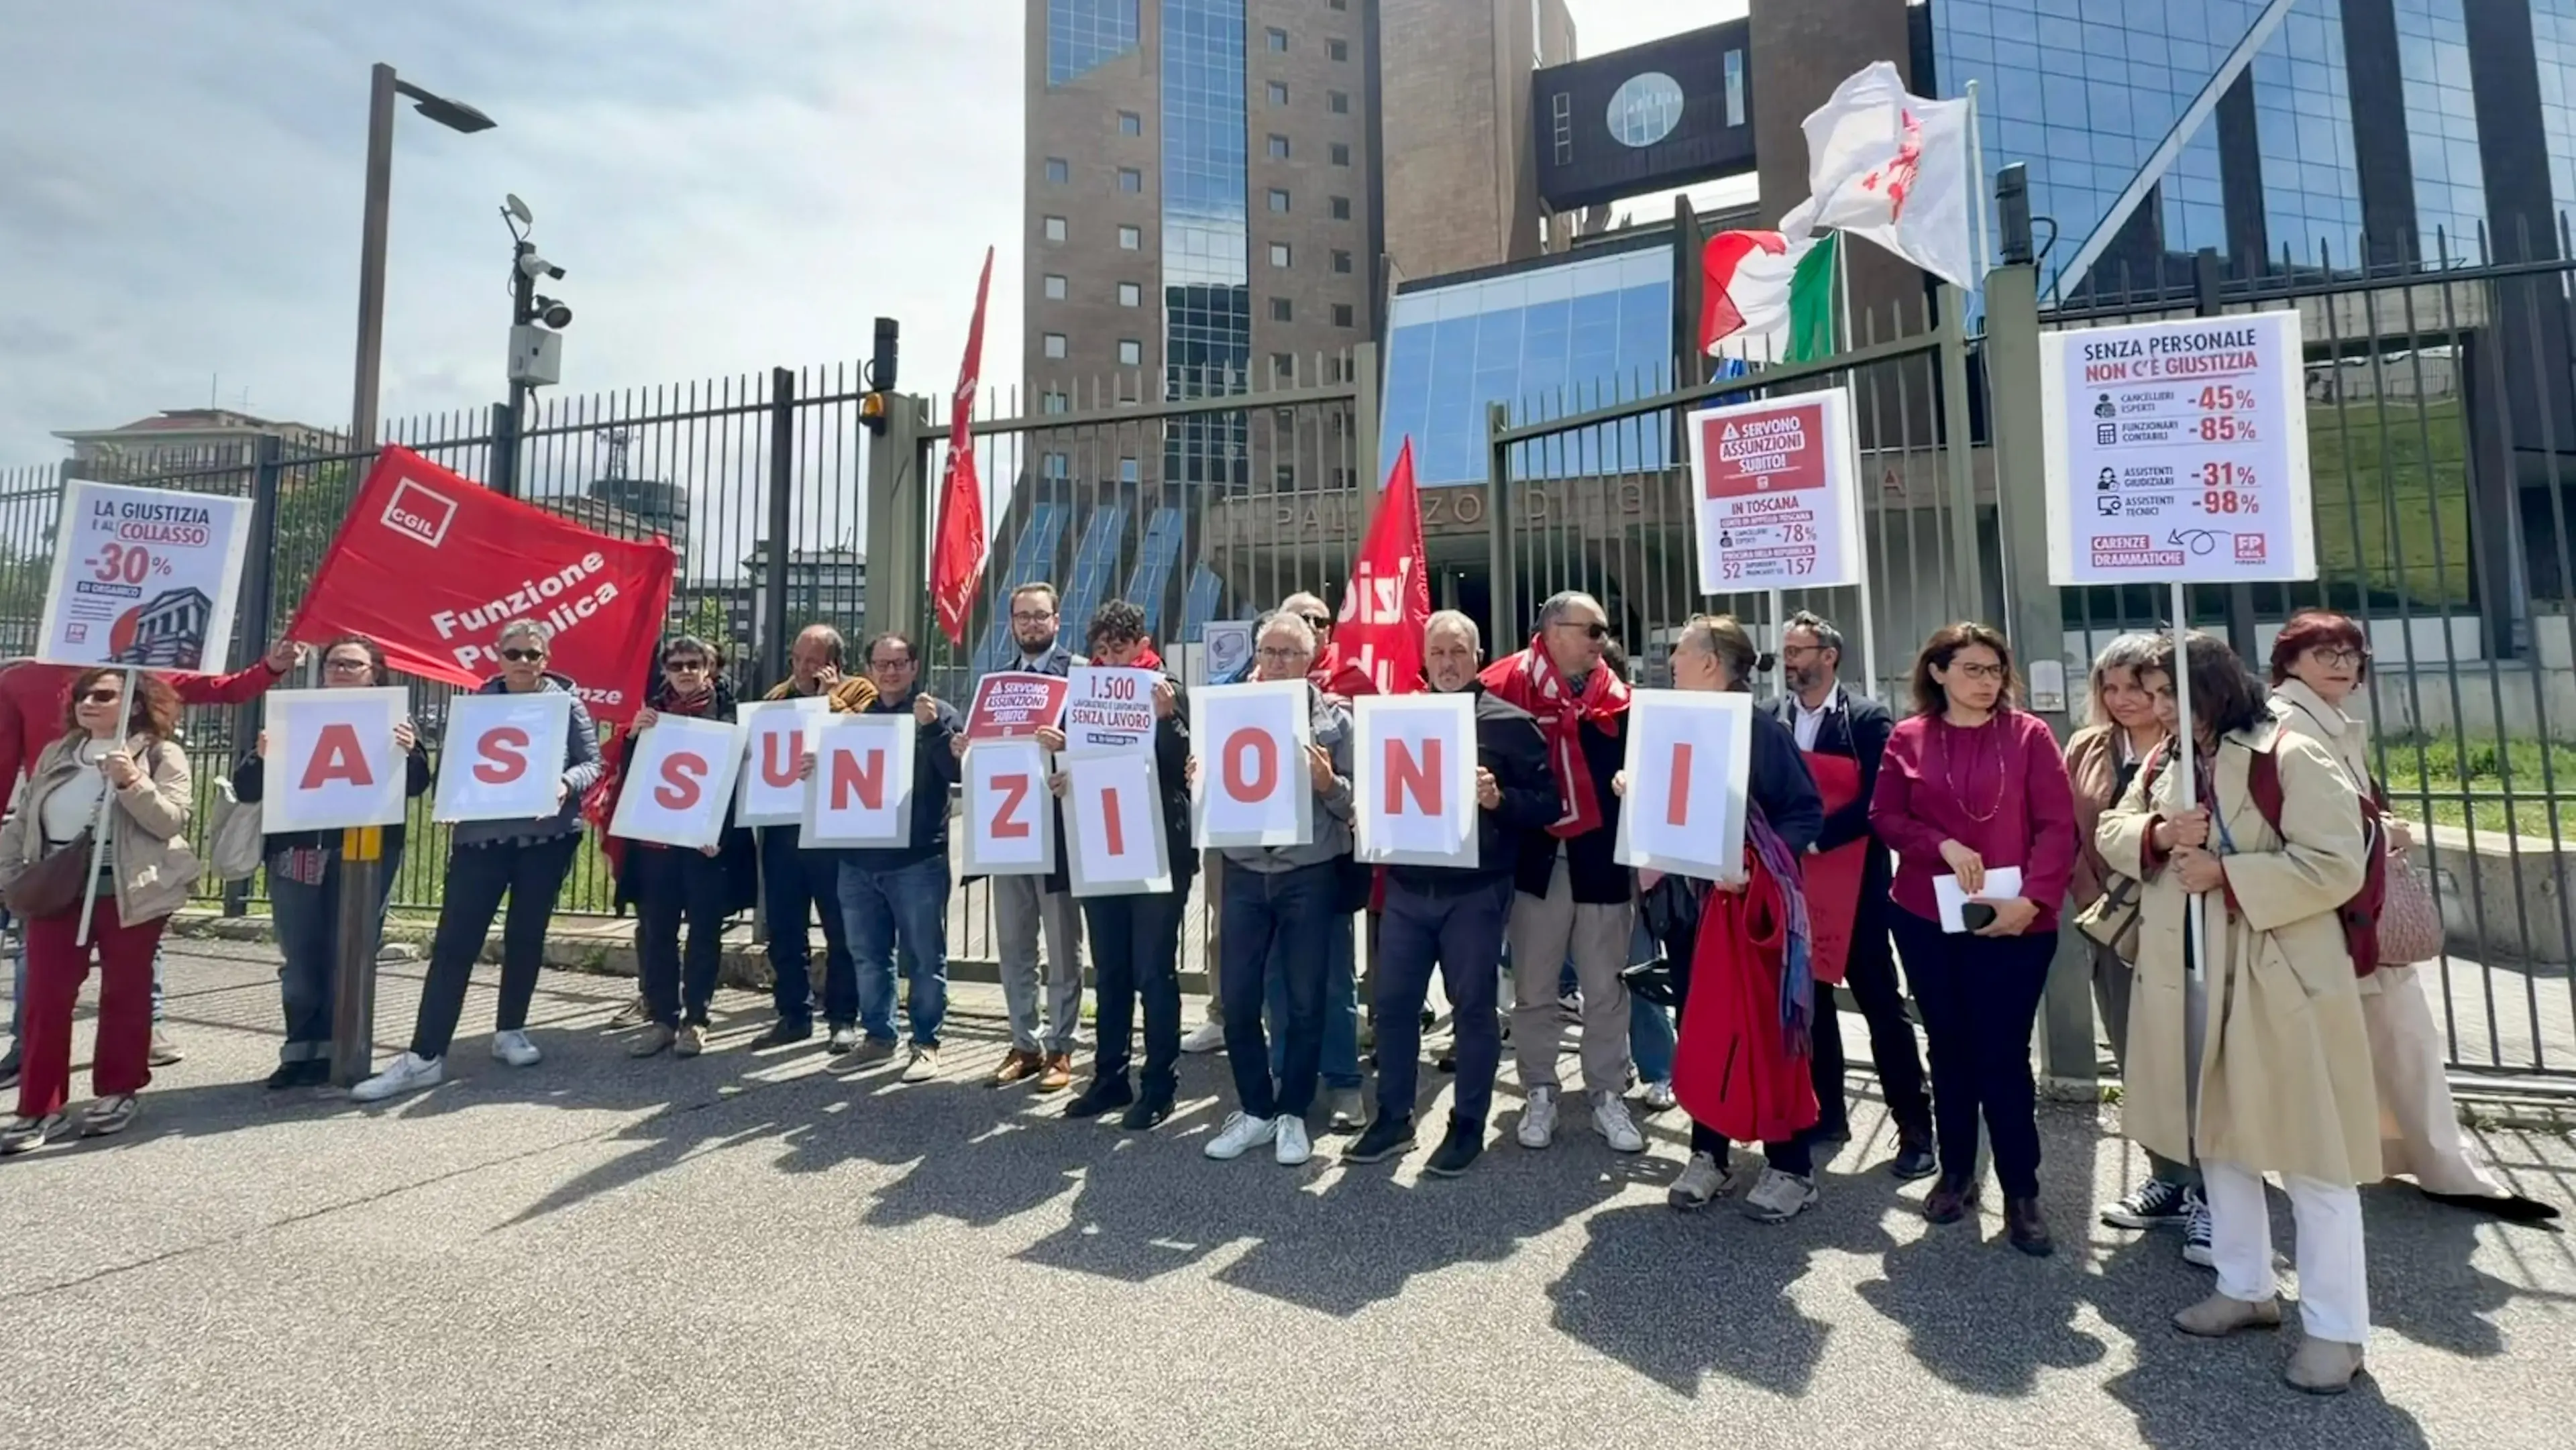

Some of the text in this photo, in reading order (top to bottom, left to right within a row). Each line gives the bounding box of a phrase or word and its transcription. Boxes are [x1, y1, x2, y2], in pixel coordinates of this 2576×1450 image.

[2084, 329, 2256, 361] SENZA PERSONALE
[2086, 362, 2127, 382] NON
[2165, 350, 2257, 374] GIUSTIZIA
[2121, 392, 2174, 402] CANCELLIERI
[2121, 403, 2155, 413] ESPERTI
[2188, 384, 2255, 410] -45%
[1742, 416, 1801, 437] SERVONO
[2122, 421, 2178, 431] FUNZIONARI
[2123, 431, 2167, 442] CONTABILI
[2189, 416, 2257, 441] -85%
[1723, 434, 1802, 458] ASSUNZIONI
[1739, 453, 1786, 473] SUBITO!
[2124, 466, 2174, 477] ASSISTENTI
[2191, 461, 2255, 486] -31%
[2124, 477, 2174, 488] GIUDIZIARI
[95, 501, 209, 524] LA GIUSTIZIA
[1731, 495, 1799, 515] IN TOSCANA
[2125, 496, 2175, 506] ASSISTENTI
[2126, 507, 2159, 517] TECNICI
[2192, 490, 2259, 514] -98%
[120, 522, 205, 544] COLLASSO
[391, 508, 433, 537] CGIL
[2093, 536, 2147, 549] CARENZE
[2237, 536, 2263, 549] FP
[85, 543, 172, 584] -30%
[1723, 562, 1741, 579] 52
[1786, 557, 1815, 575] 157
[2094, 552, 2181, 567] DRAMMATICHE
[431, 551, 604, 640] Funzione
[1091, 675, 1136, 701] 1.500
[1072, 708, 1151, 728] SENZA LAVORO
[299, 724, 373, 789] A
[472, 726, 529, 784] S
[762, 730, 803, 788] U
[1222, 726, 1278, 803] O
[654, 752, 708, 810] S
[830, 749, 884, 810] N
[1385, 738, 1442, 816] N
[1667, 742, 1692, 826] I
[990, 774, 1029, 838] Z
[1101, 787, 1124, 856] I
